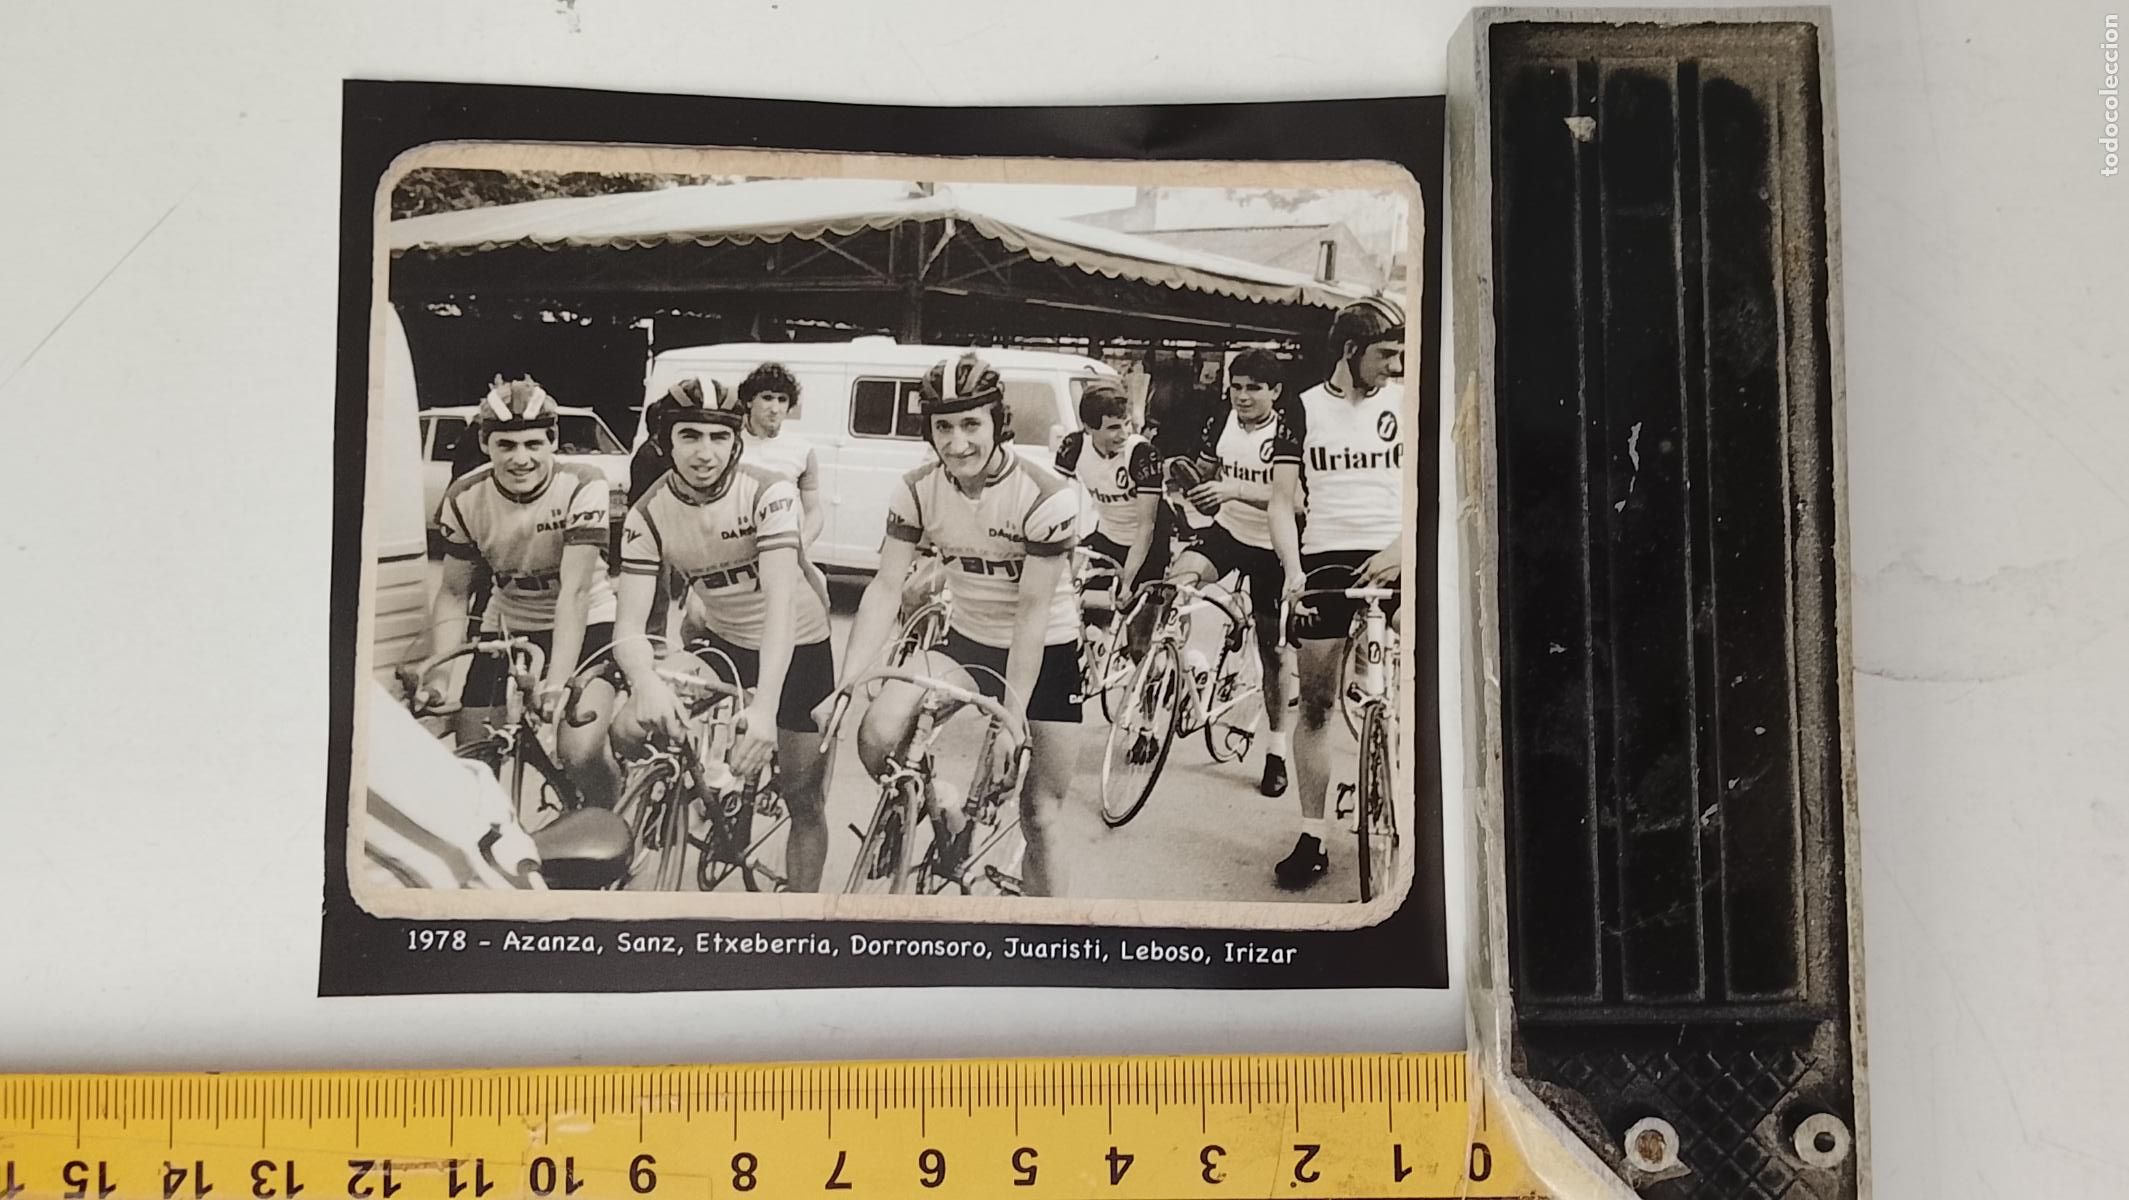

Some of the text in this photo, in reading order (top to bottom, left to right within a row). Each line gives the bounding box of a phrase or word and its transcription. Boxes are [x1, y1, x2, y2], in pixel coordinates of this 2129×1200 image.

[408, 929, 466, 951] 1978
[503, 930, 603, 955] Azanza,
[617, 932, 684, 956] Sanz,
[696, 932, 839, 957] Etxeberria,
[850, 934, 992, 960] Dorronsoro,
[1004, 937, 1108, 962] Juaristi,
[1121, 940, 1211, 965] Leboso,
[1225, 942, 1297, 964] Irizar
[62, 1160, 117, 1200] 15
[163, 1160, 213, 1200] 14
[250, 1159, 305, 1199] 13
[347, 1159, 402, 1199] 12
[447, 1158, 494, 1199] 11
[529, 1156, 584, 1196] 10
[629, 1154, 657, 1194] 9
[730, 1151, 758, 1192] 8
[824, 1150, 853, 1190] 7
[918, 1148, 946, 1189] 6
[1011, 1146, 1039, 1187] 5
[1104, 1146, 1134, 1186] 4
[1199, 1144, 1227, 1184] 3
[1293, 1143, 1321, 1183] 2
[1393, 1144, 1412, 1183] 1
[1469, 1142, 1491, 1183] 0
